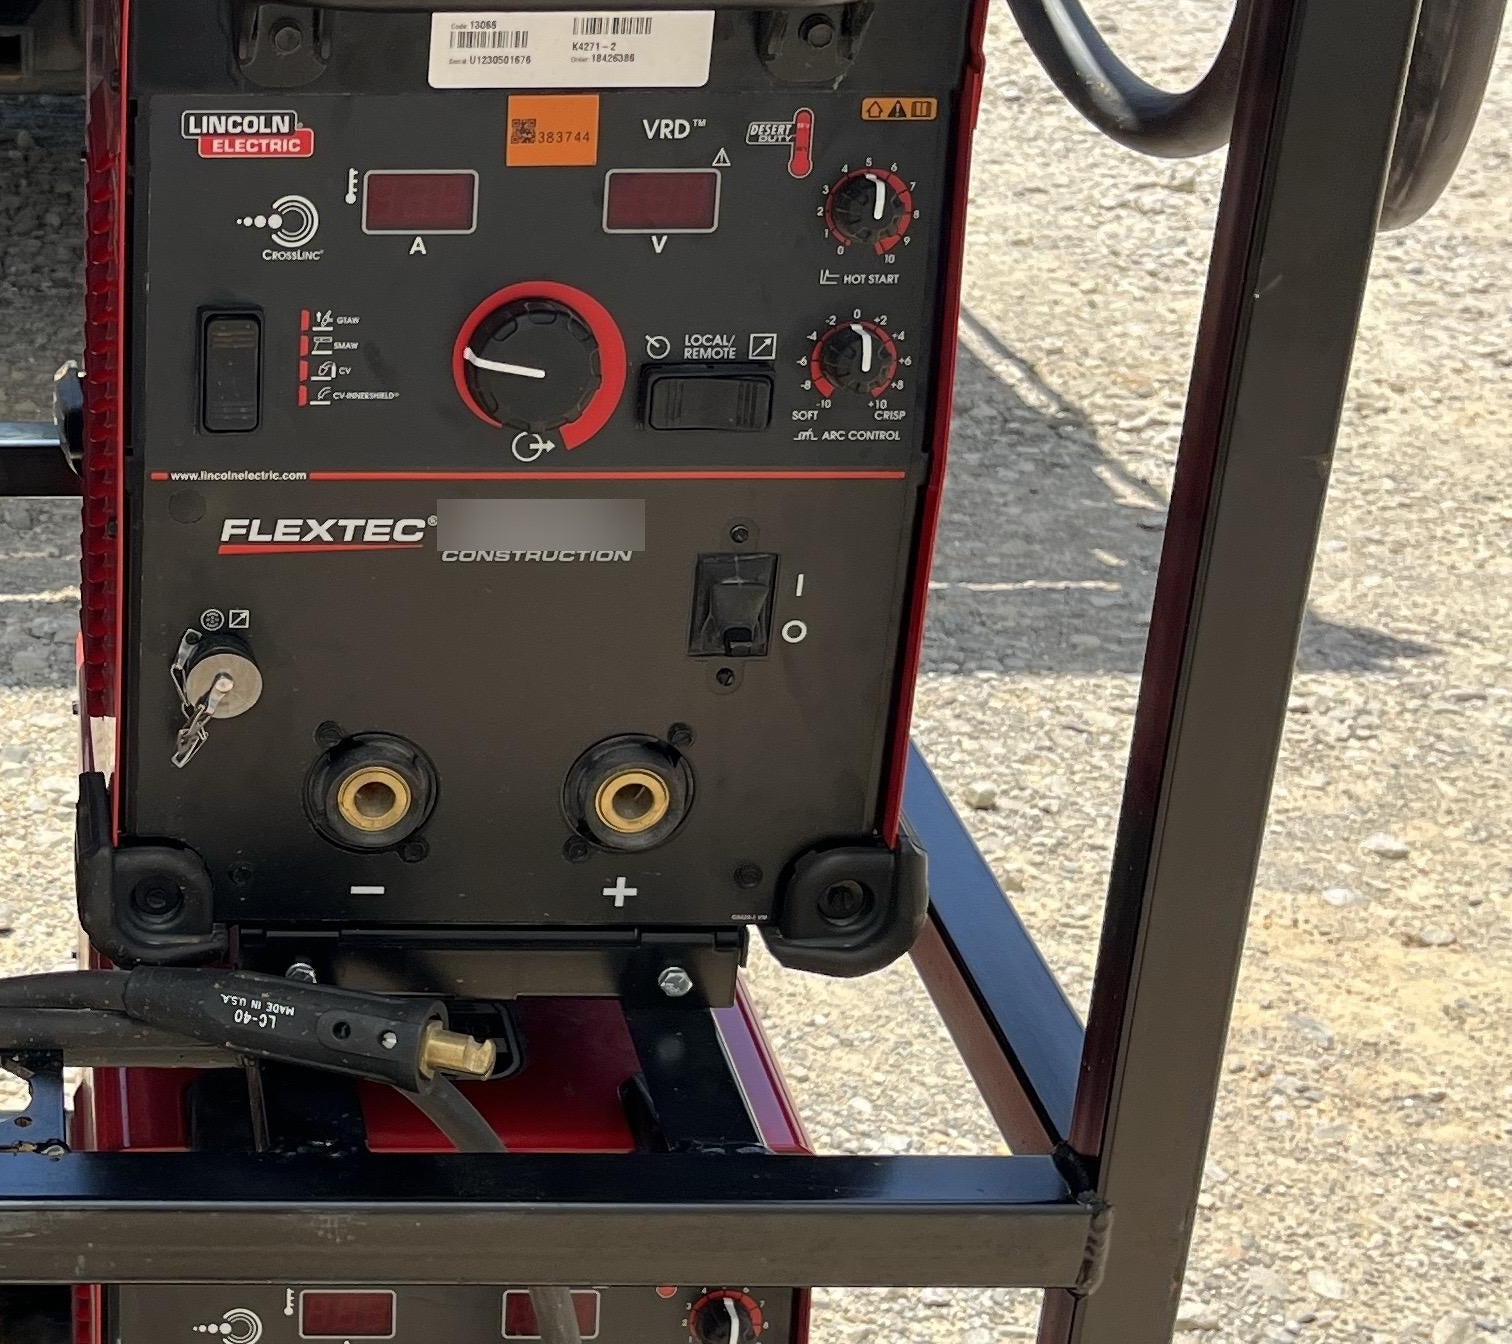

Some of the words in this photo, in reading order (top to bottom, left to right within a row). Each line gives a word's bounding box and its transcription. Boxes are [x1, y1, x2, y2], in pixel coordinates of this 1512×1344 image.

[189, 116, 289, 133] LINCOLN
[750, 124, 792, 136] DESERT
[538, 132, 590, 143] 383744
[212, 139, 301, 153] ELECTRIC
[866, 157, 872, 166] 5
[891, 163, 897, 171] 6
[823, 185, 829, 194] 3
[911, 182, 916, 191] 7
[817, 207, 823, 216] 2
[913, 210, 919, 219] 8
[825, 229, 828, 238] 1
[410, 237, 426, 254] A
[652, 236, 667, 253] V
[904, 237, 910, 245] 9
[837, 246, 844, 254] 0
[885, 254, 895, 263] 10
[844, 274, 866, 284] HOT
[869, 274, 899, 284] START
[685, 335, 735, 347] LOCAL/
[684, 348, 736, 359] REMOTE
[792, 411, 818, 420] SOFT
[875, 411, 905, 420] CRISP
[822, 431, 845, 440] ARC
[848, 431, 900, 440] CONTROL
[171, 470, 306, 481] www.lincolnelectric.com
[221, 519, 425, 541] FLEXTEC
[442, 551, 632, 562] CONSTRUCTION
[251, 1000, 261, 1009] IN
[266, 1002, 294, 1016] MADE
[234, 1009, 277, 1029] LC-40
